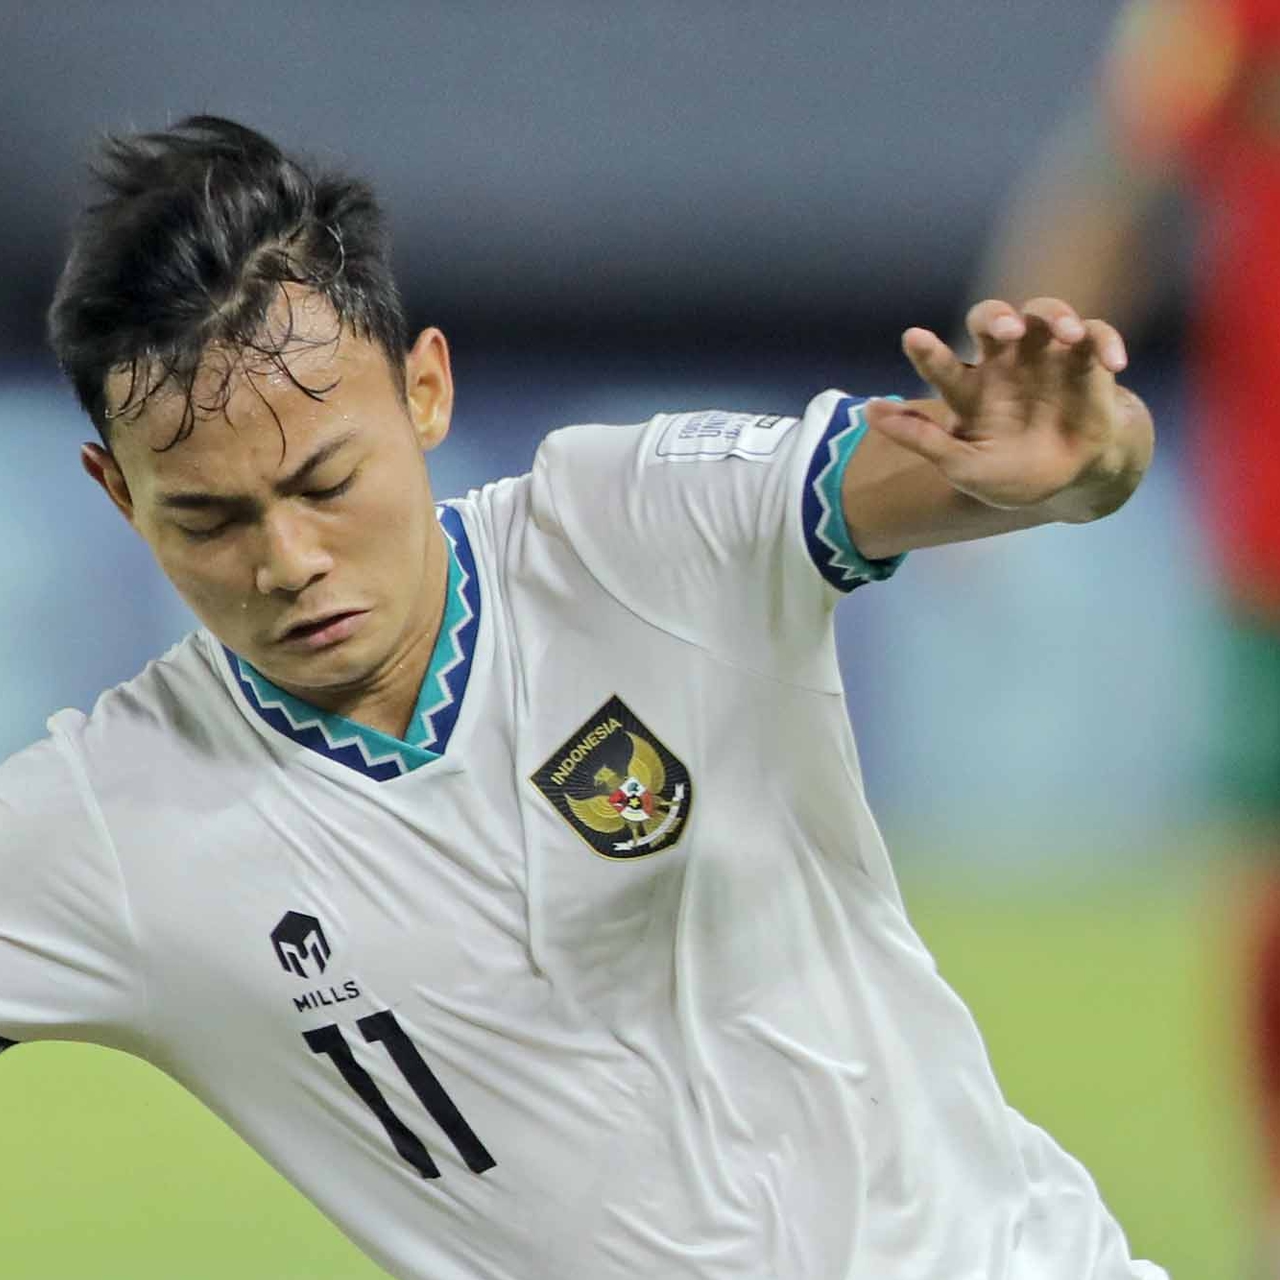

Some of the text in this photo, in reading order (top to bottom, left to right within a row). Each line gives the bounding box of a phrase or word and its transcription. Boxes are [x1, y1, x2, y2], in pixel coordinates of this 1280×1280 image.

[550, 717, 623, 786] INDONESIA
[292, 980, 361, 1013] MILLS
[302, 1009, 498, 1180] 11
